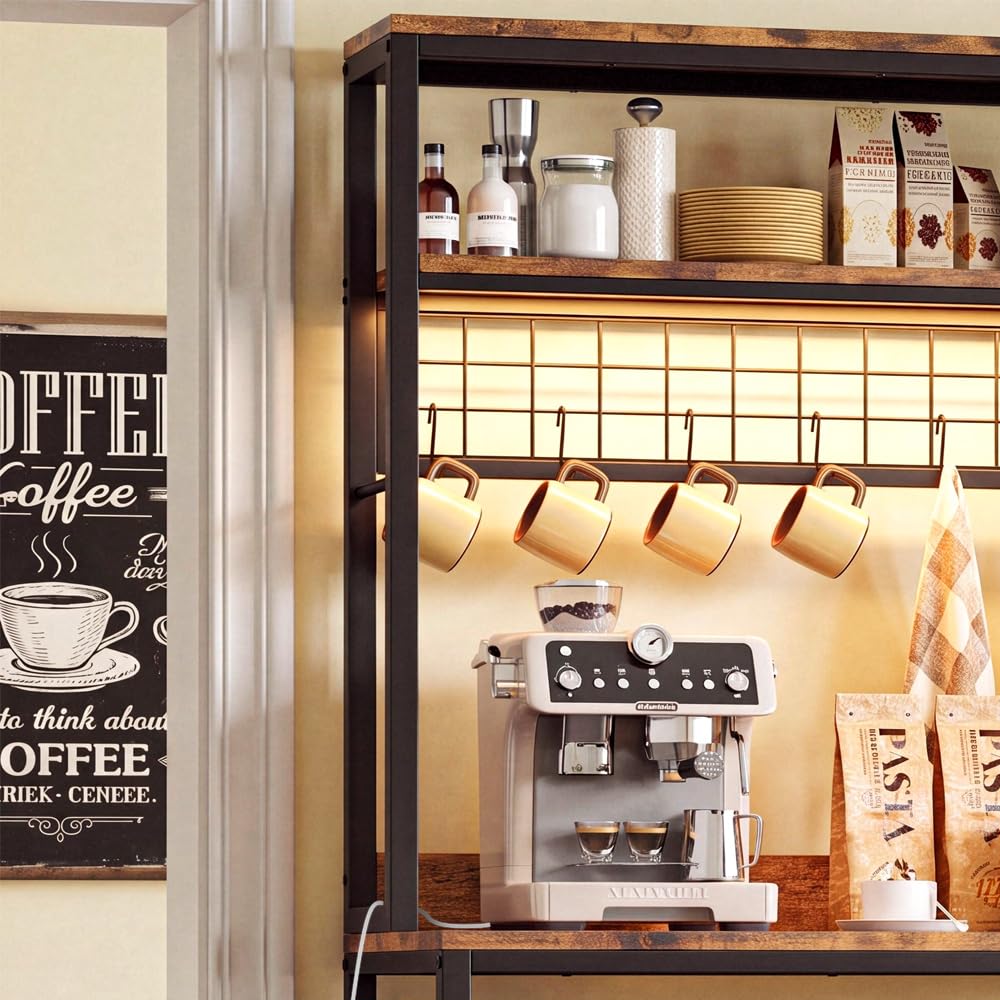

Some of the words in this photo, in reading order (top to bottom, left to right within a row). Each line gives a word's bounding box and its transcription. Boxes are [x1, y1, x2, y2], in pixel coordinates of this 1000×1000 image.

[0, 707, 24, 730] to
[33, 704, 97, 730] think
[0, 742, 150, 776] OFFEE
[0, 785, 53, 803] RIEK
